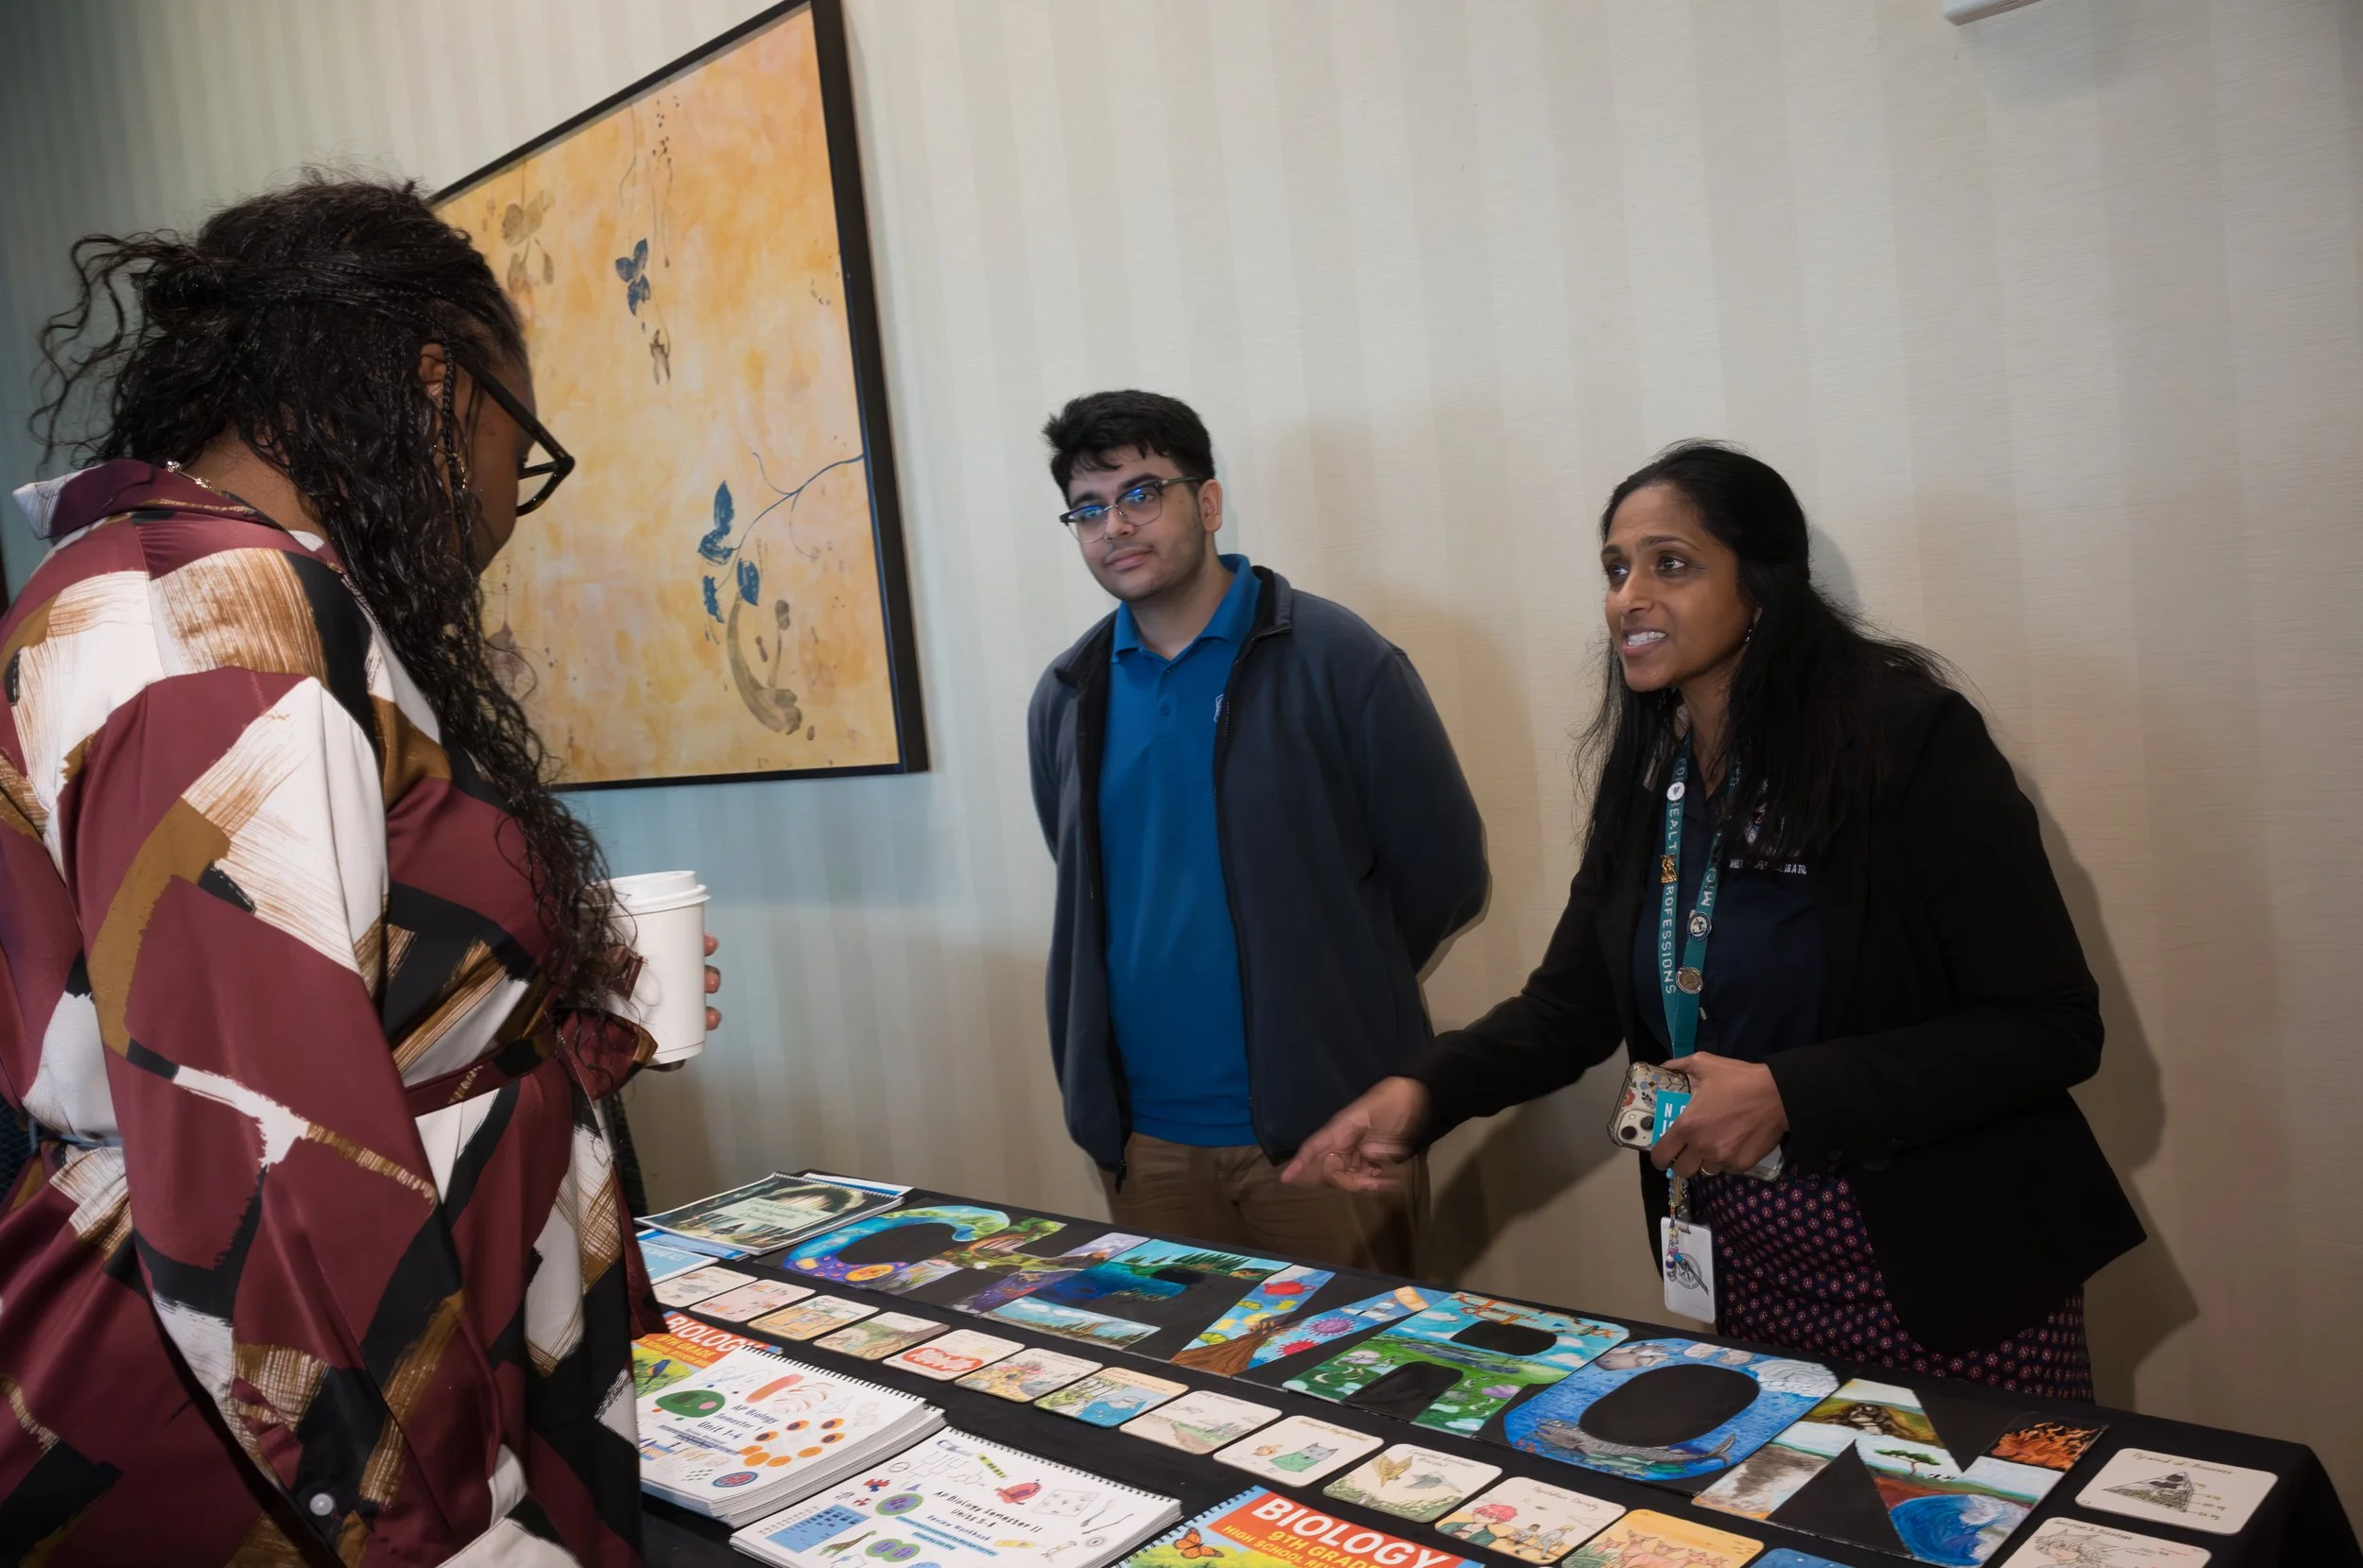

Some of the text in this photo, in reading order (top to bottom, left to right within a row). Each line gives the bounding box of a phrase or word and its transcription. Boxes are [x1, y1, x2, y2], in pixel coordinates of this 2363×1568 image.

[1666, 801, 1680, 857] EALT
[1661, 885, 1677, 994] ROFESSIONS
[677, 1342, 716, 1358] GRADE
[714, 1413, 754, 1429] Semester
[731, 1404, 780, 1424] AP Biology
[697, 1422, 745, 1440] Unit 1-4
[932, 1490, 949, 1499] AP
[945, 1495, 983, 1512] Biology
[983, 1508, 1031, 1528] Semester
[949, 1508, 978, 1522] Units
[953, 1524, 992, 1542] Workbook
[1250, 1497, 1452, 1568] BIOLOGY
[1267, 1530, 1311, 1551] 9TH
[1222, 1525, 1256, 1546] HIGH
[1254, 1540, 1304, 1563] SCHOOL
